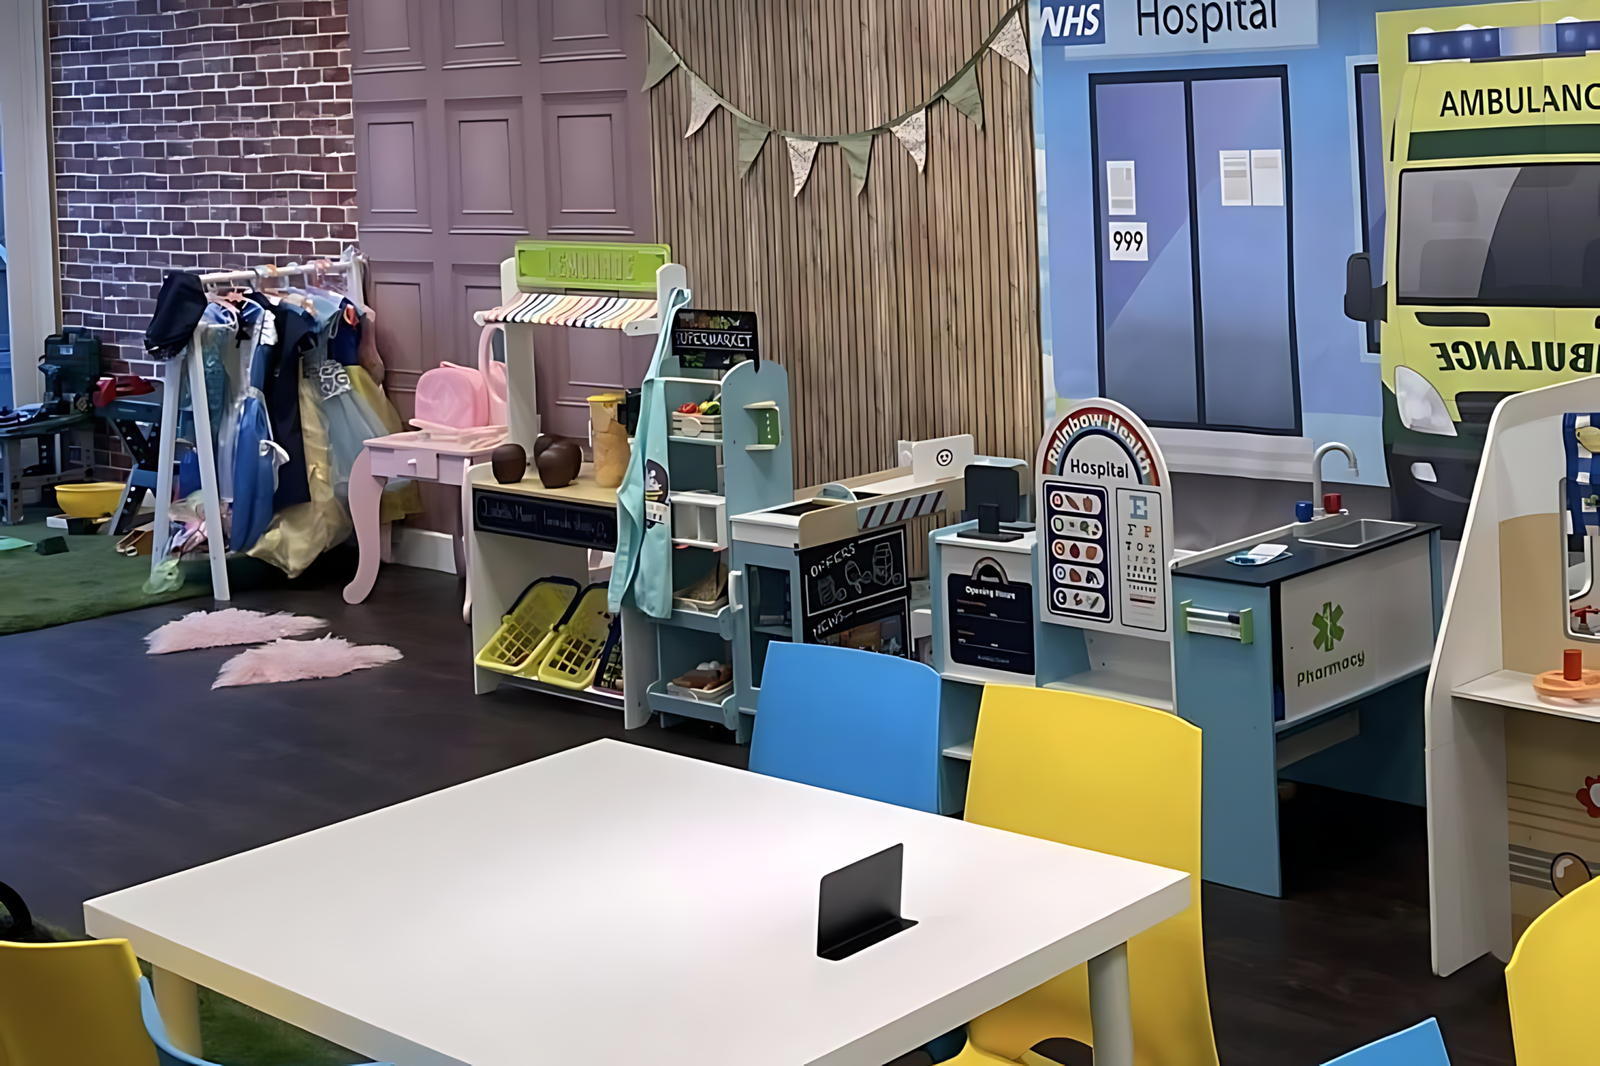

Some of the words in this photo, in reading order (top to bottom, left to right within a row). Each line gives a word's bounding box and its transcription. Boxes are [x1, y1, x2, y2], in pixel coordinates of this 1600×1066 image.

[1040, 4, 1100, 37] NHS
[1137, 0, 1277, 43] Hospital
[1113, 231, 1144, 252] 999
[1070, 458, 1129, 480] Hospital
[1129, 495, 1148, 520] E
[1297, 650, 1365, 687] Pharmacy
